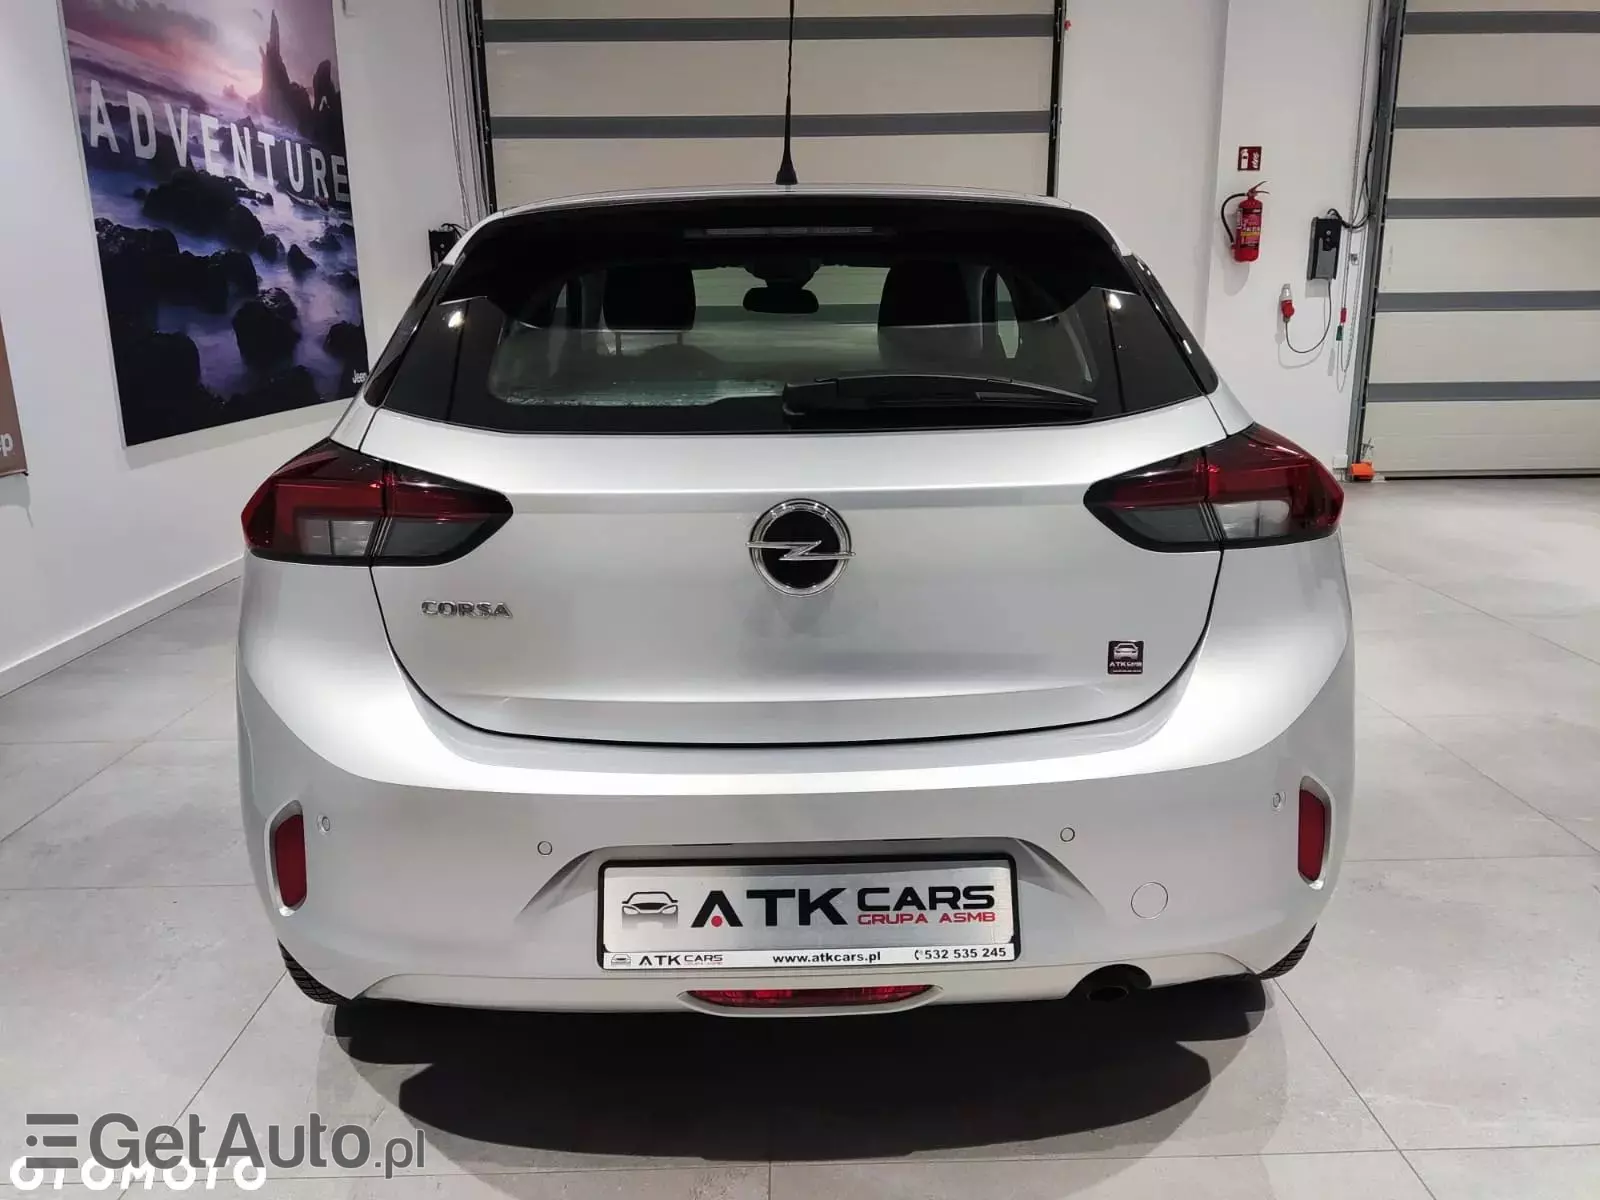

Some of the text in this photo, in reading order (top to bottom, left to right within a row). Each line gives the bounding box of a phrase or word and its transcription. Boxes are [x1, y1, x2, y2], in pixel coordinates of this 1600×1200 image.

[90, 79, 349, 202] ADVENTURE
[421, 600, 513, 619] CORSA
[691, 886, 995, 928] ATK CARS
[857, 911, 996, 925] GRUPA ASMB
[638, 955, 681, 966] ATK
[684, 954, 723, 962] CARS
[772, 951, 881, 963] www.atkcars.pl
[925, 947, 1006, 959] 532 535 245
